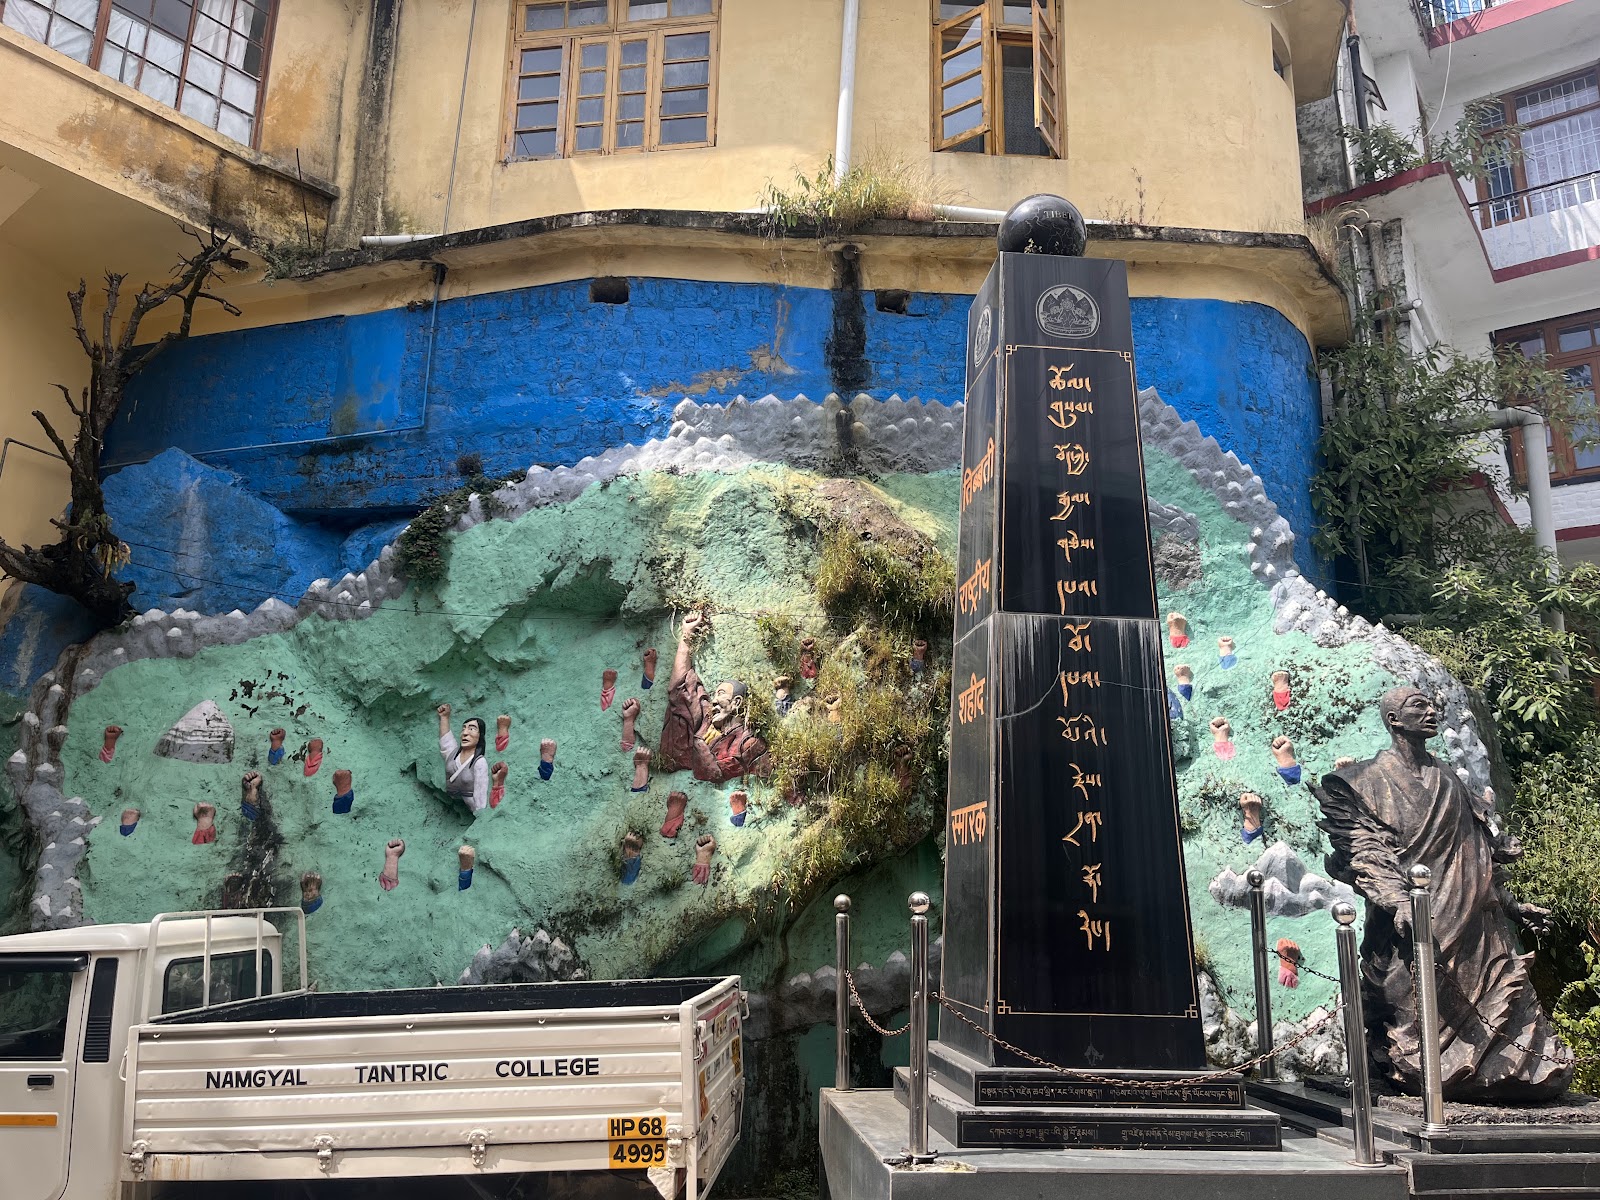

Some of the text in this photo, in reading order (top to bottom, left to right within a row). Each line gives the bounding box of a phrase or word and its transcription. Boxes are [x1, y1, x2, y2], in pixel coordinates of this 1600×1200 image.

[1043, 210, 1073, 220] TIBET
[962, 436, 997, 512] तिब्बती
[959, 558, 992, 616] राष्ट्रीय
[958, 672, 986, 725] शहीद
[950, 800, 988, 846] स्मारक
[205, 1057, 600, 1089] NAMGYAL TANTRIC COLLEGE
[610, 1117, 663, 1137] HP 68
[613, 1143, 665, 1163] 4995
